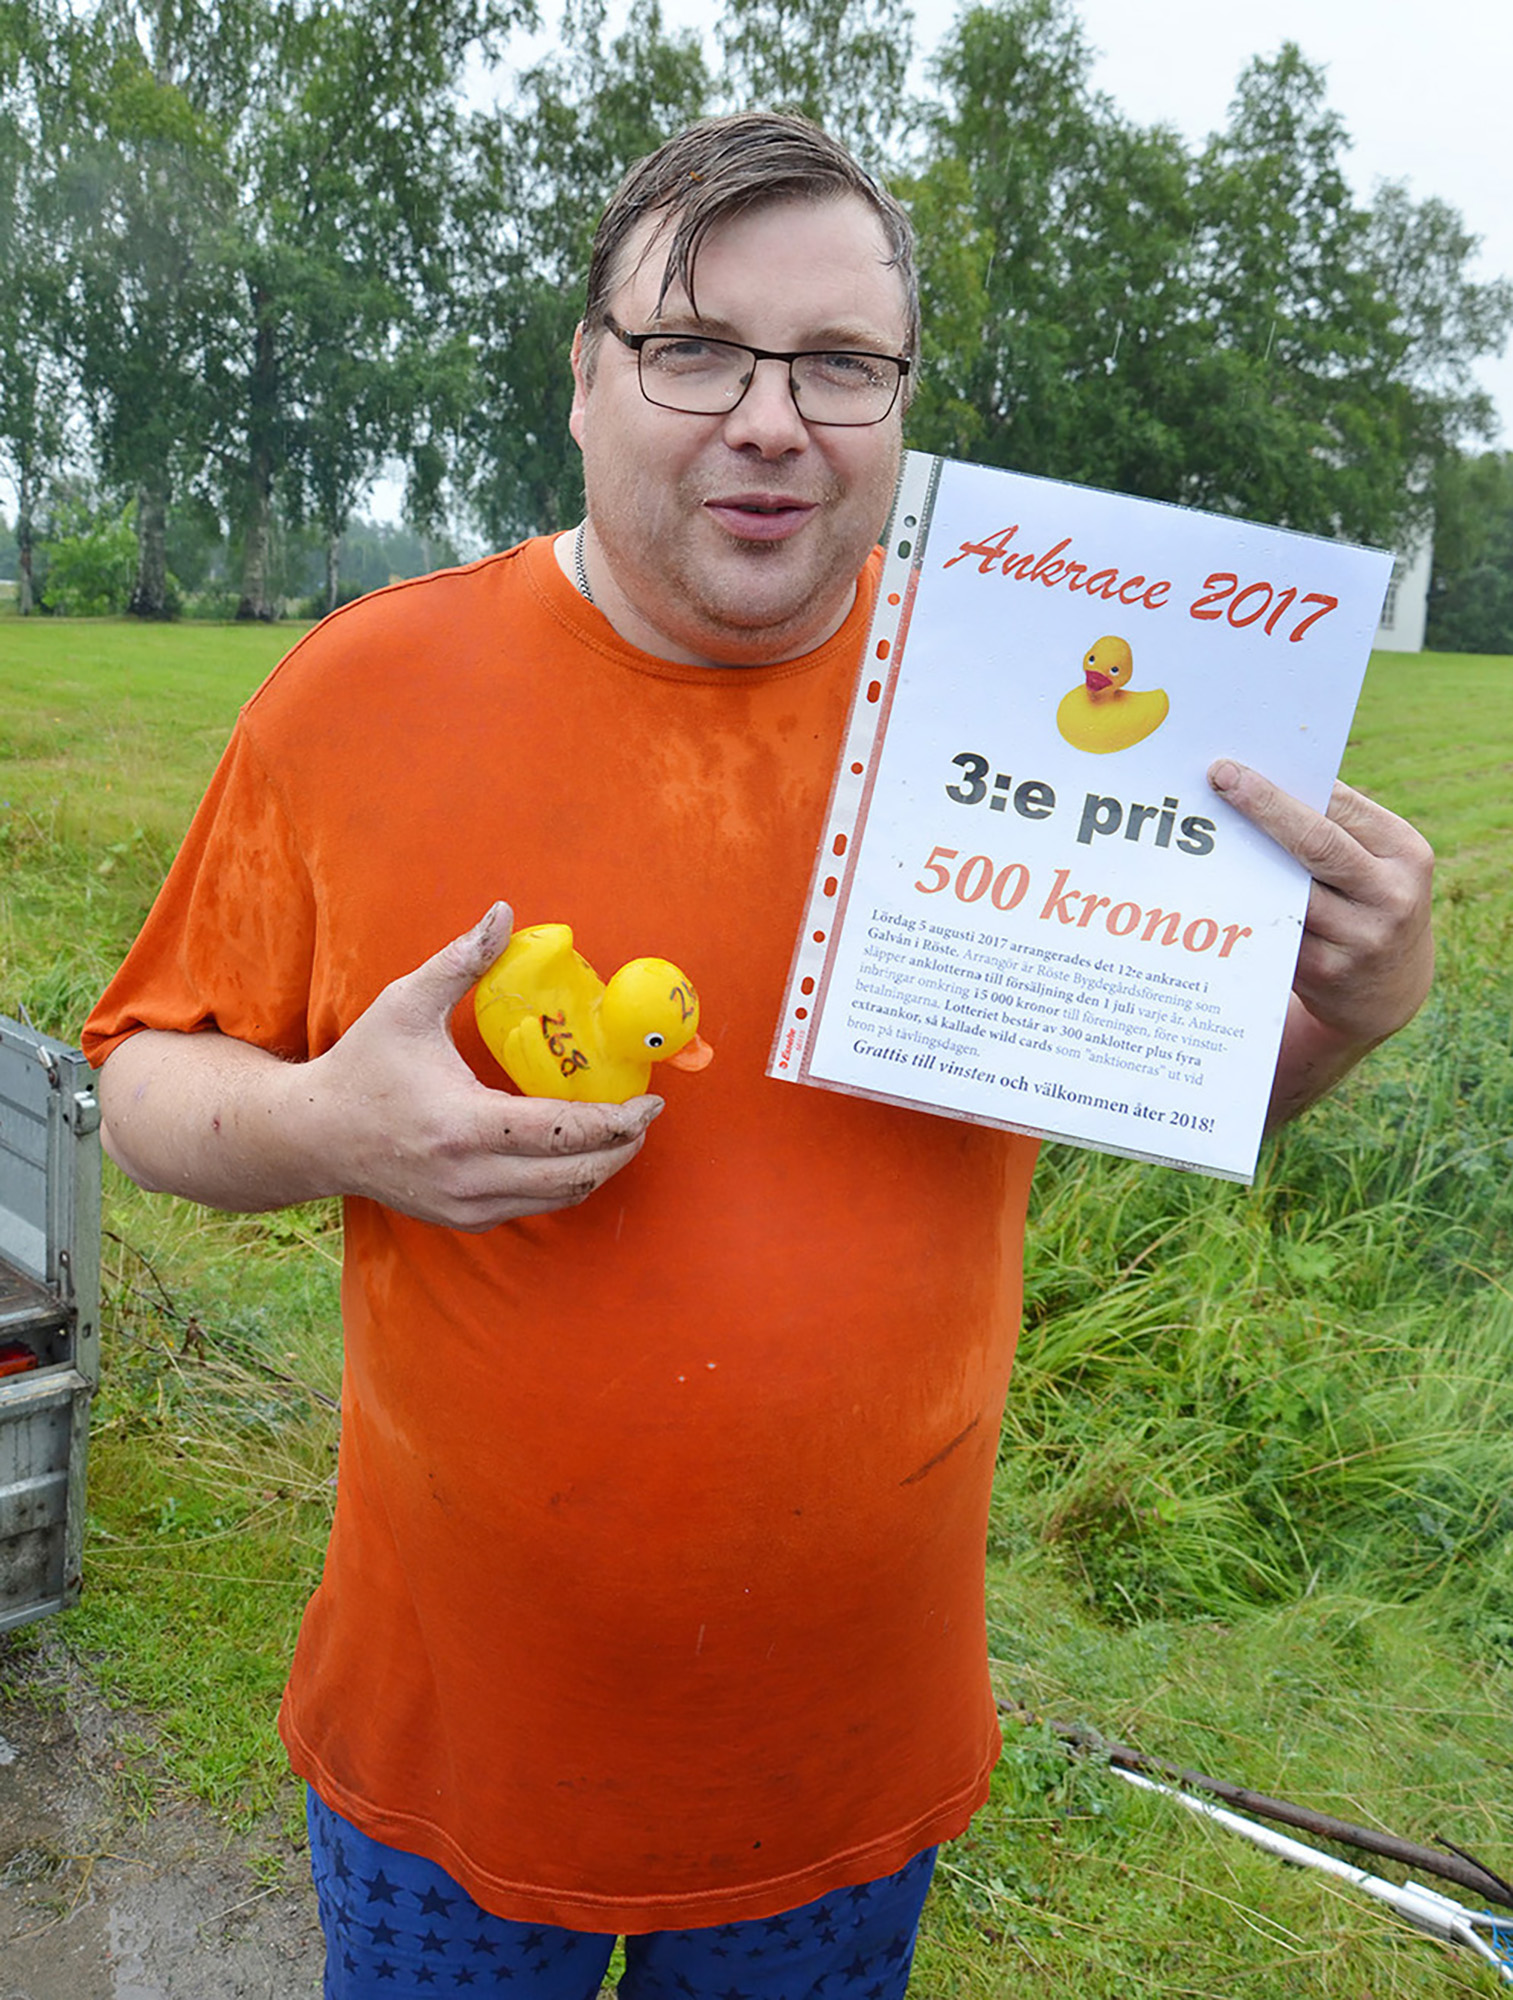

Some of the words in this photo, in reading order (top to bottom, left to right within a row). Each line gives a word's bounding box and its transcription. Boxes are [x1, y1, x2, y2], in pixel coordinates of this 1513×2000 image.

[943, 524, 1172, 610] Ankrace
[1190, 572, 1339, 642] 2017
[945, 752, 1057, 821] 3:e
[1076, 792, 1219, 857] pris
[914, 845, 1031, 914] 500
[1039, 869, 1254, 959] kronor
[863, 944, 907, 964] släpper
[908, 956, 983, 981] anklotterna
[984, 972, 1004, 986] till
[1005, 975, 1075, 1005] försäljning
[1075, 991, 1100, 1007] den
[1103, 997, 1110, 1009] 1
[1111, 999, 1136, 1015] juli
[1137, 1007, 1169, 1024] varje
[1187, 1016, 1245, 1039] Ankracet
[871, 908, 917, 933] Lördag
[918, 919, 927, 932] 5
[928, 925, 976, 943] augusti
[977, 932, 1009, 949] 2017
[1009, 943, 1092, 968] arrangerades
[1093, 958, 1115, 974] det
[1144, 972, 1201, 992] ankracet
[1202, 981, 1209, 994] i
[914, 936, 920, 949] i
[921, 938, 960, 958] Röste.
[962, 948, 1020, 971] Arrangör
[1020, 960, 1035, 974] är
[1036, 963, 1071, 983] Röste
[1194, 1001, 1222, 1015] som
[539, 1008, 592, 1078] 268
[846, 1014, 876, 1033] bron
[876, 1024, 894, 1038] på
[850, 999, 922, 1024] extraankor,
[925, 1014, 938, 1027] så
[940, 1016, 987, 1038] kallade
[989, 1029, 1018, 1045] wild
[1018, 1037, 1053, 1052] cards
[1054, 1045, 1082, 1060] som
[1167, 1070, 1182, 1082] ut
[1183, 1072, 1205, 1086] vid
[859, 961, 916, 986] inbringar
[916, 977, 971, 1000] omkring
[990, 991, 1015, 1007] 000
[1015, 996, 1061, 1017] kronor
[1062, 1007, 1081, 1021] till
[1153, 1026, 1179, 1043] före
[944, 998, 999, 1022] Lotteriet
[1001, 1011, 1041, 1031] består
[1041, 1024, 1058, 1034] av
[1058, 1025, 1084, 1041] 300
[1084, 1032, 1144, 1054] anklotter
[1144, 1045, 1173, 1060] plus
[1175, 1050, 1202, 1067] fyra
[853, 1039, 909, 1064] Grattis
[911, 1053, 937, 1070] till
[939, 1060, 996, 1084] vinsten
[999, 1075, 1029, 1092] och
[1034, 1081, 1129, 1115] välkommen
[1132, 1102, 1166, 1122] åter
[1169, 1110, 1215, 1134] 2018!
